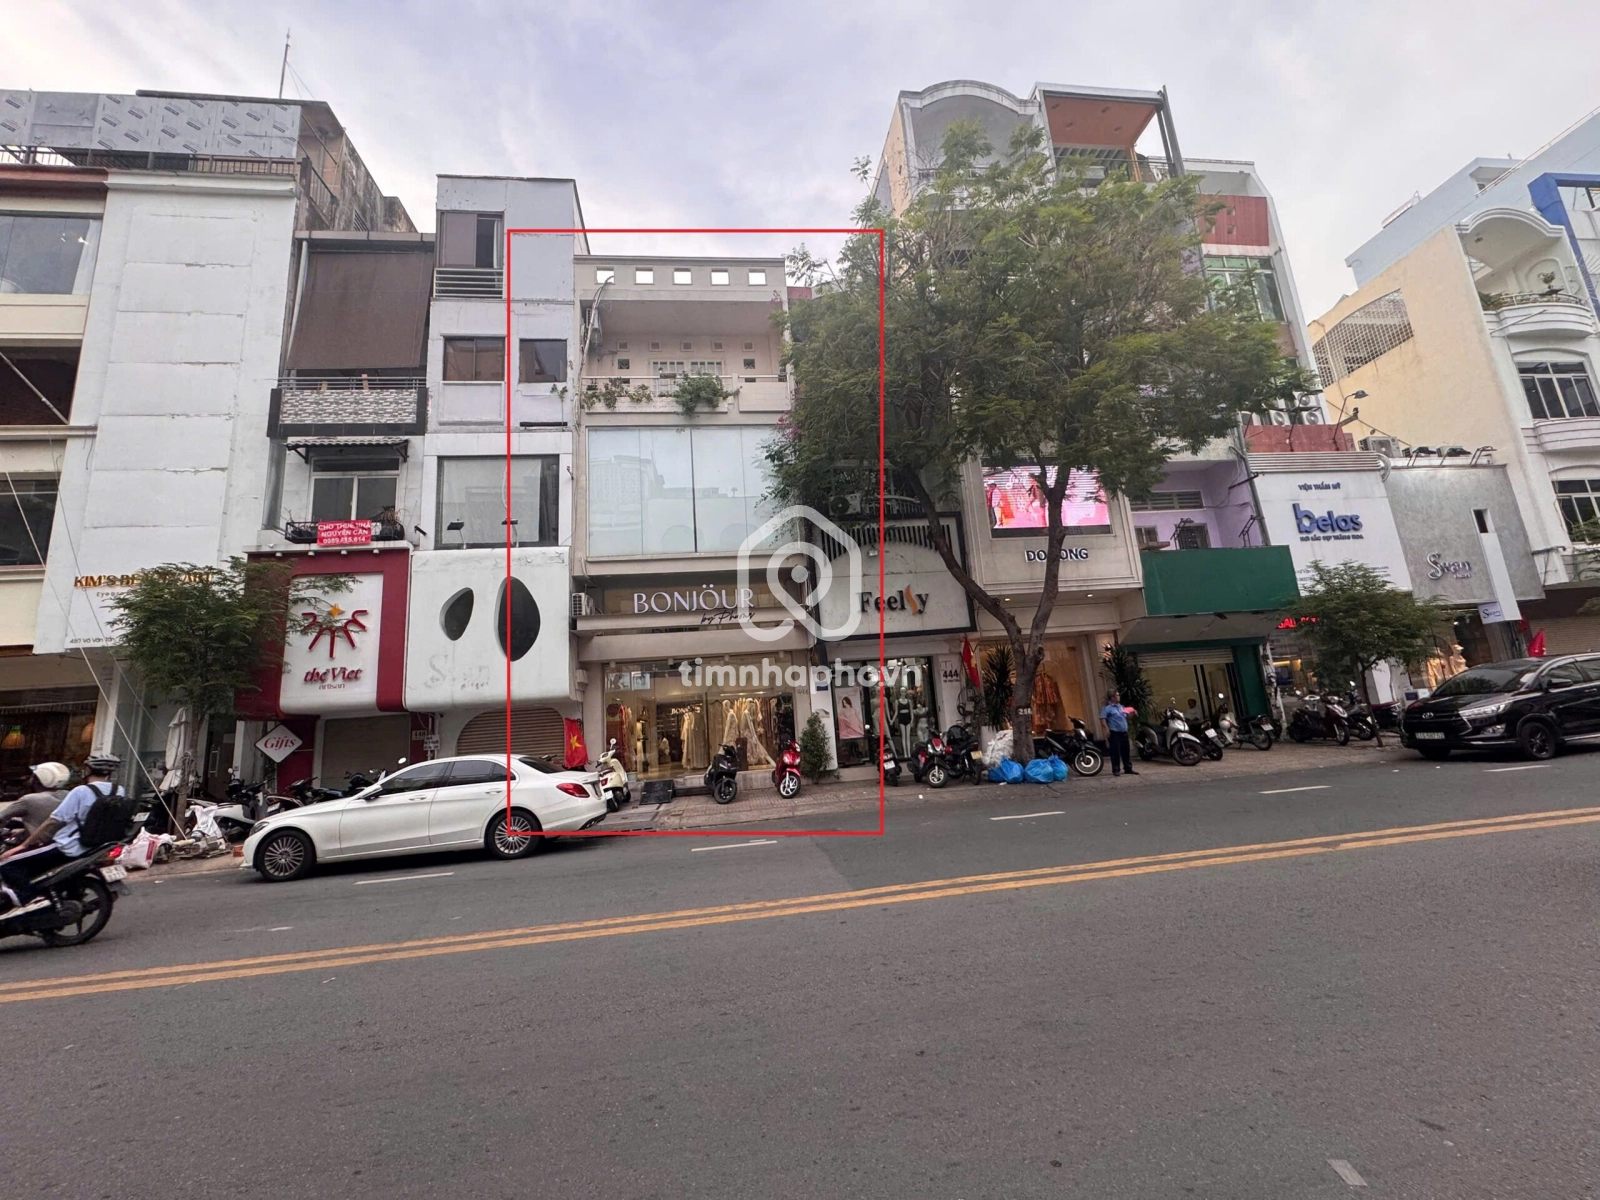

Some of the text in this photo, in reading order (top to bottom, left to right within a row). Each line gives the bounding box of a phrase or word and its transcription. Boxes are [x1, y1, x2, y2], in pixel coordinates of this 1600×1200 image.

[1292, 503, 1363, 533] belas
[74, 574, 117, 588] KIM'S
[633, 583, 754, 614] BONJÖUR
[303, 667, 329, 684] the
[942, 669, 959, 679] 444
[263, 736, 296, 751] Gifts
